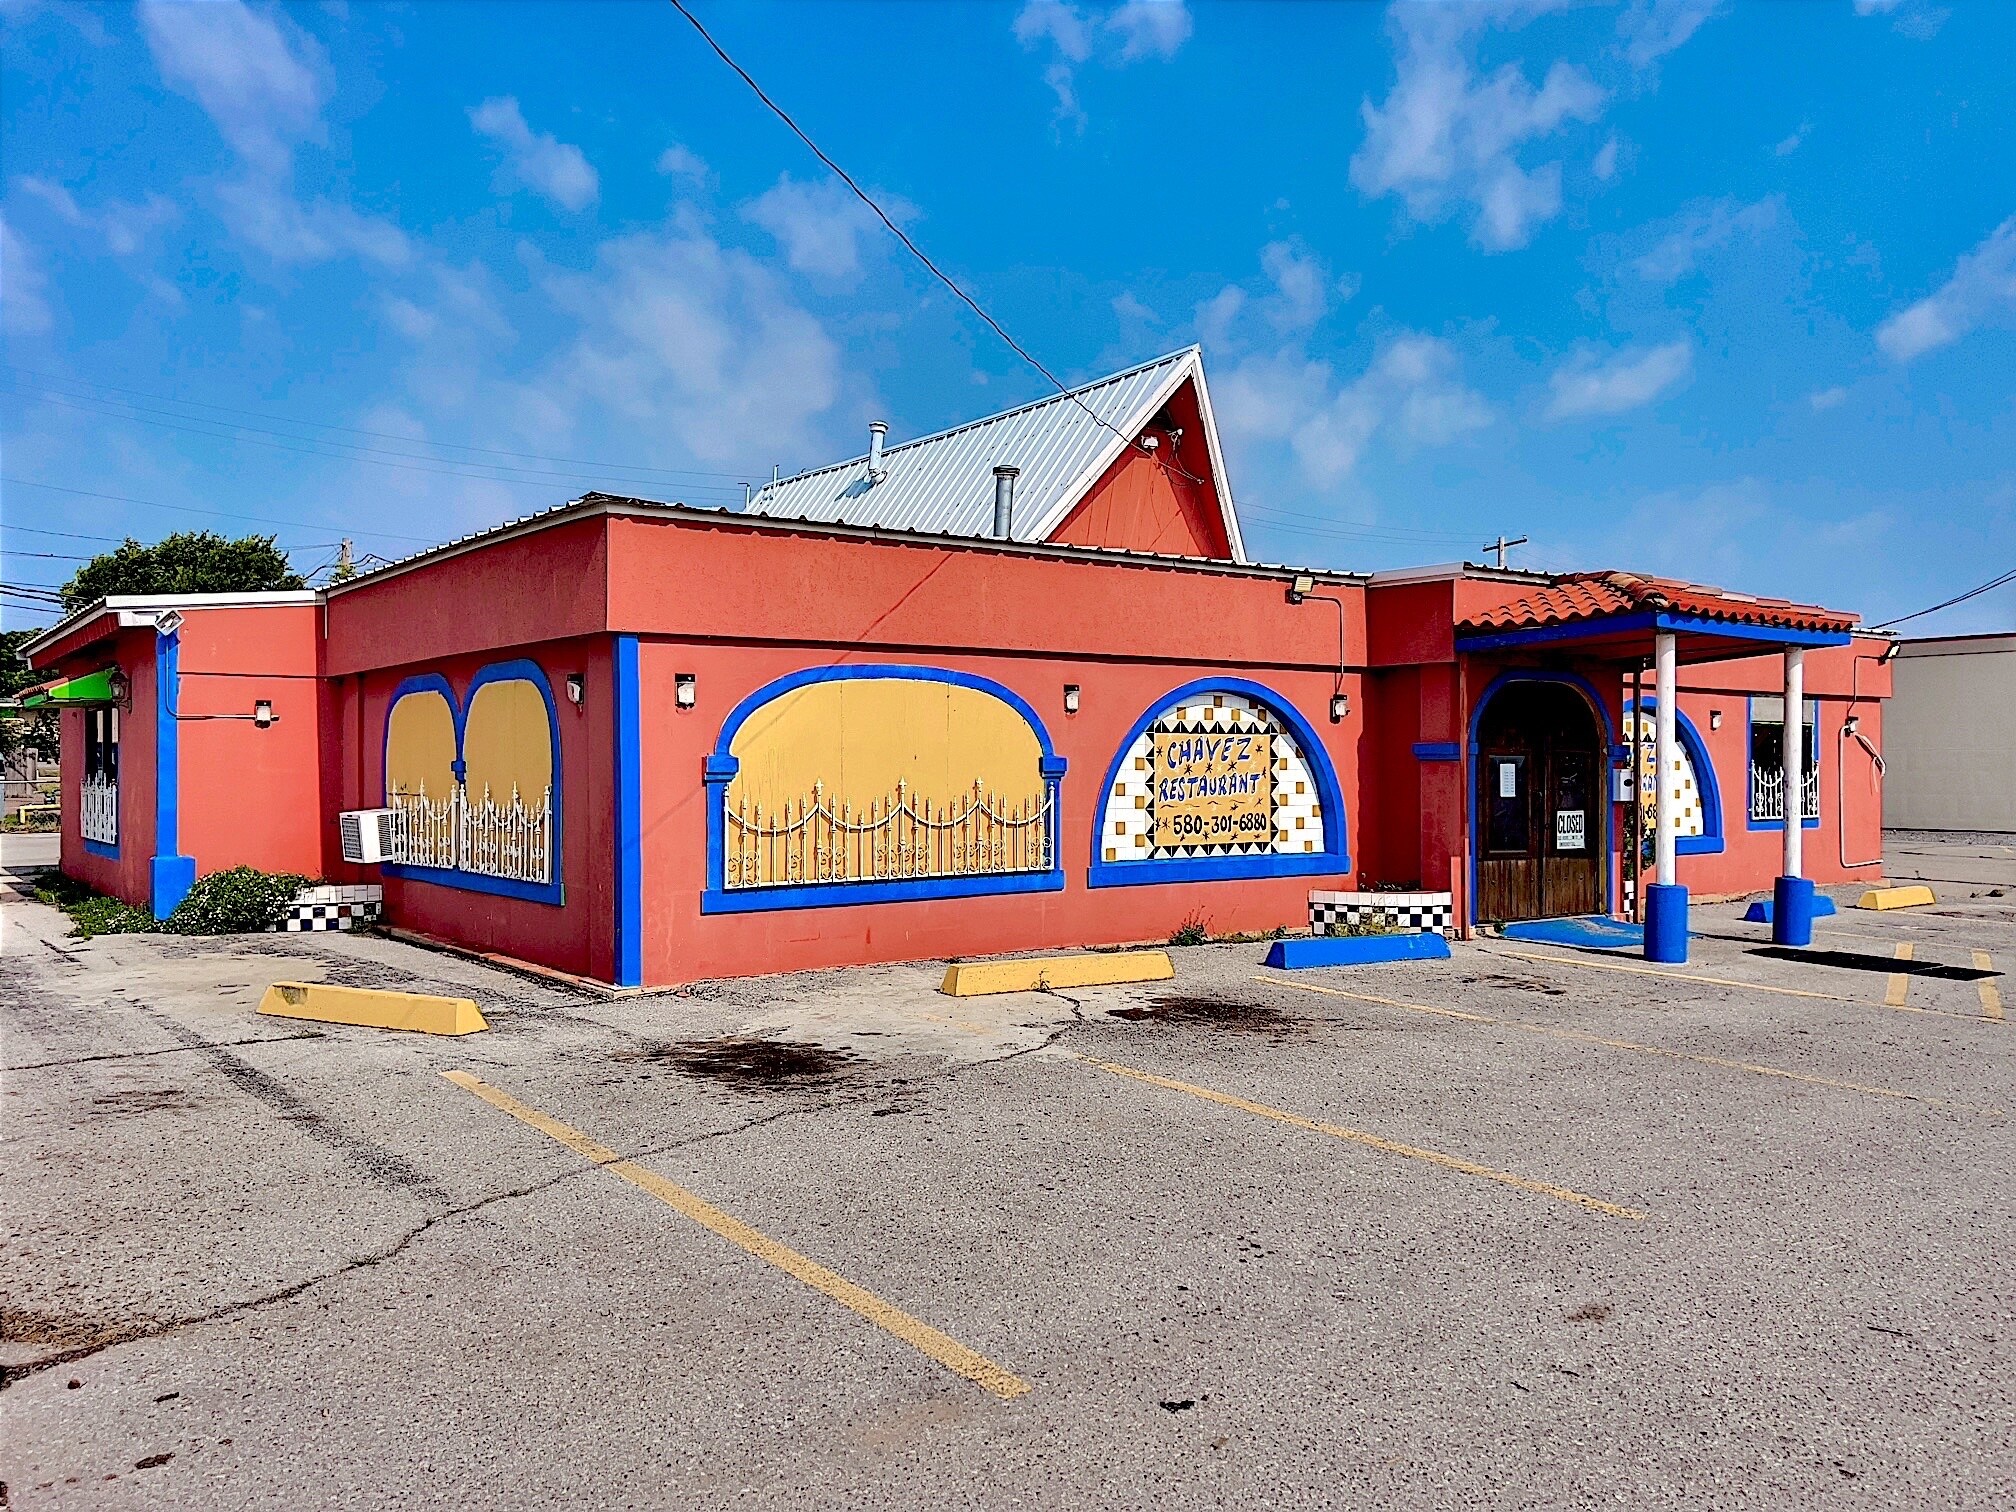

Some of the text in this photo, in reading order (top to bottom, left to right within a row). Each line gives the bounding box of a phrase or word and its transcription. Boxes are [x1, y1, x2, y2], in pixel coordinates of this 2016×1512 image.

[1167, 736, 1252, 769] CHAVEZ
[1158, 771, 1261, 803] RESTAURANT
[1173, 812, 1267, 835] 580-301-6880
[1557, 814, 1583, 834] CLOSED
